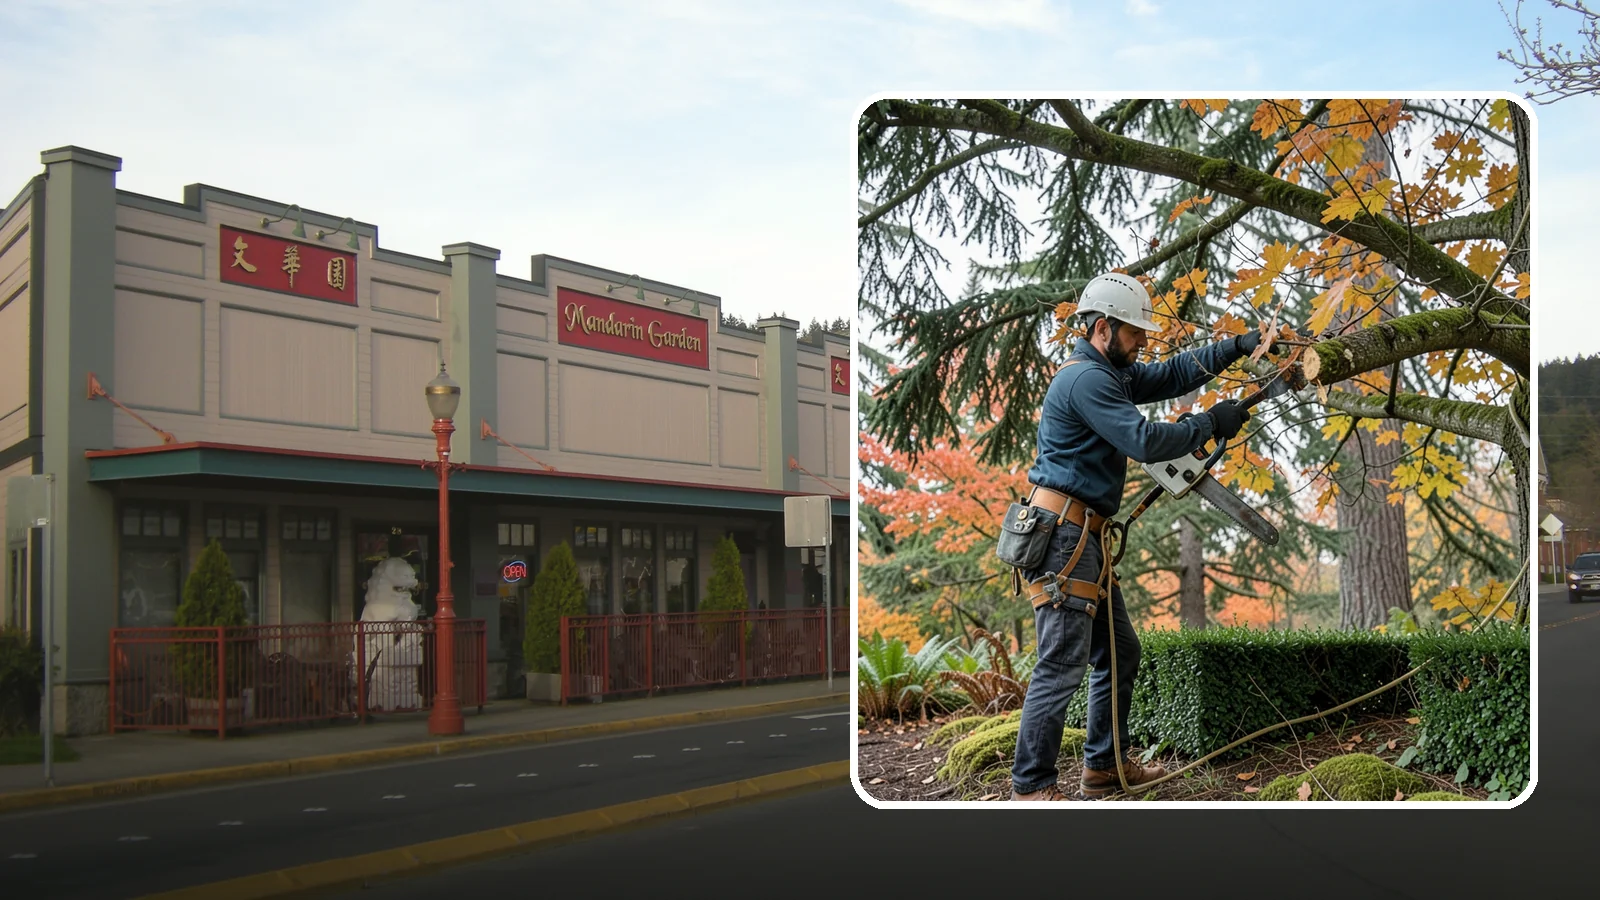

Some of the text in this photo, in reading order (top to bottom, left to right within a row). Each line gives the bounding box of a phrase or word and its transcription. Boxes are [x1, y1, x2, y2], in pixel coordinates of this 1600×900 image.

[230, 235, 347, 291] 文華園
[564, 302, 702, 352] Mandarin Garden
[503, 565, 527, 578] OPEN
